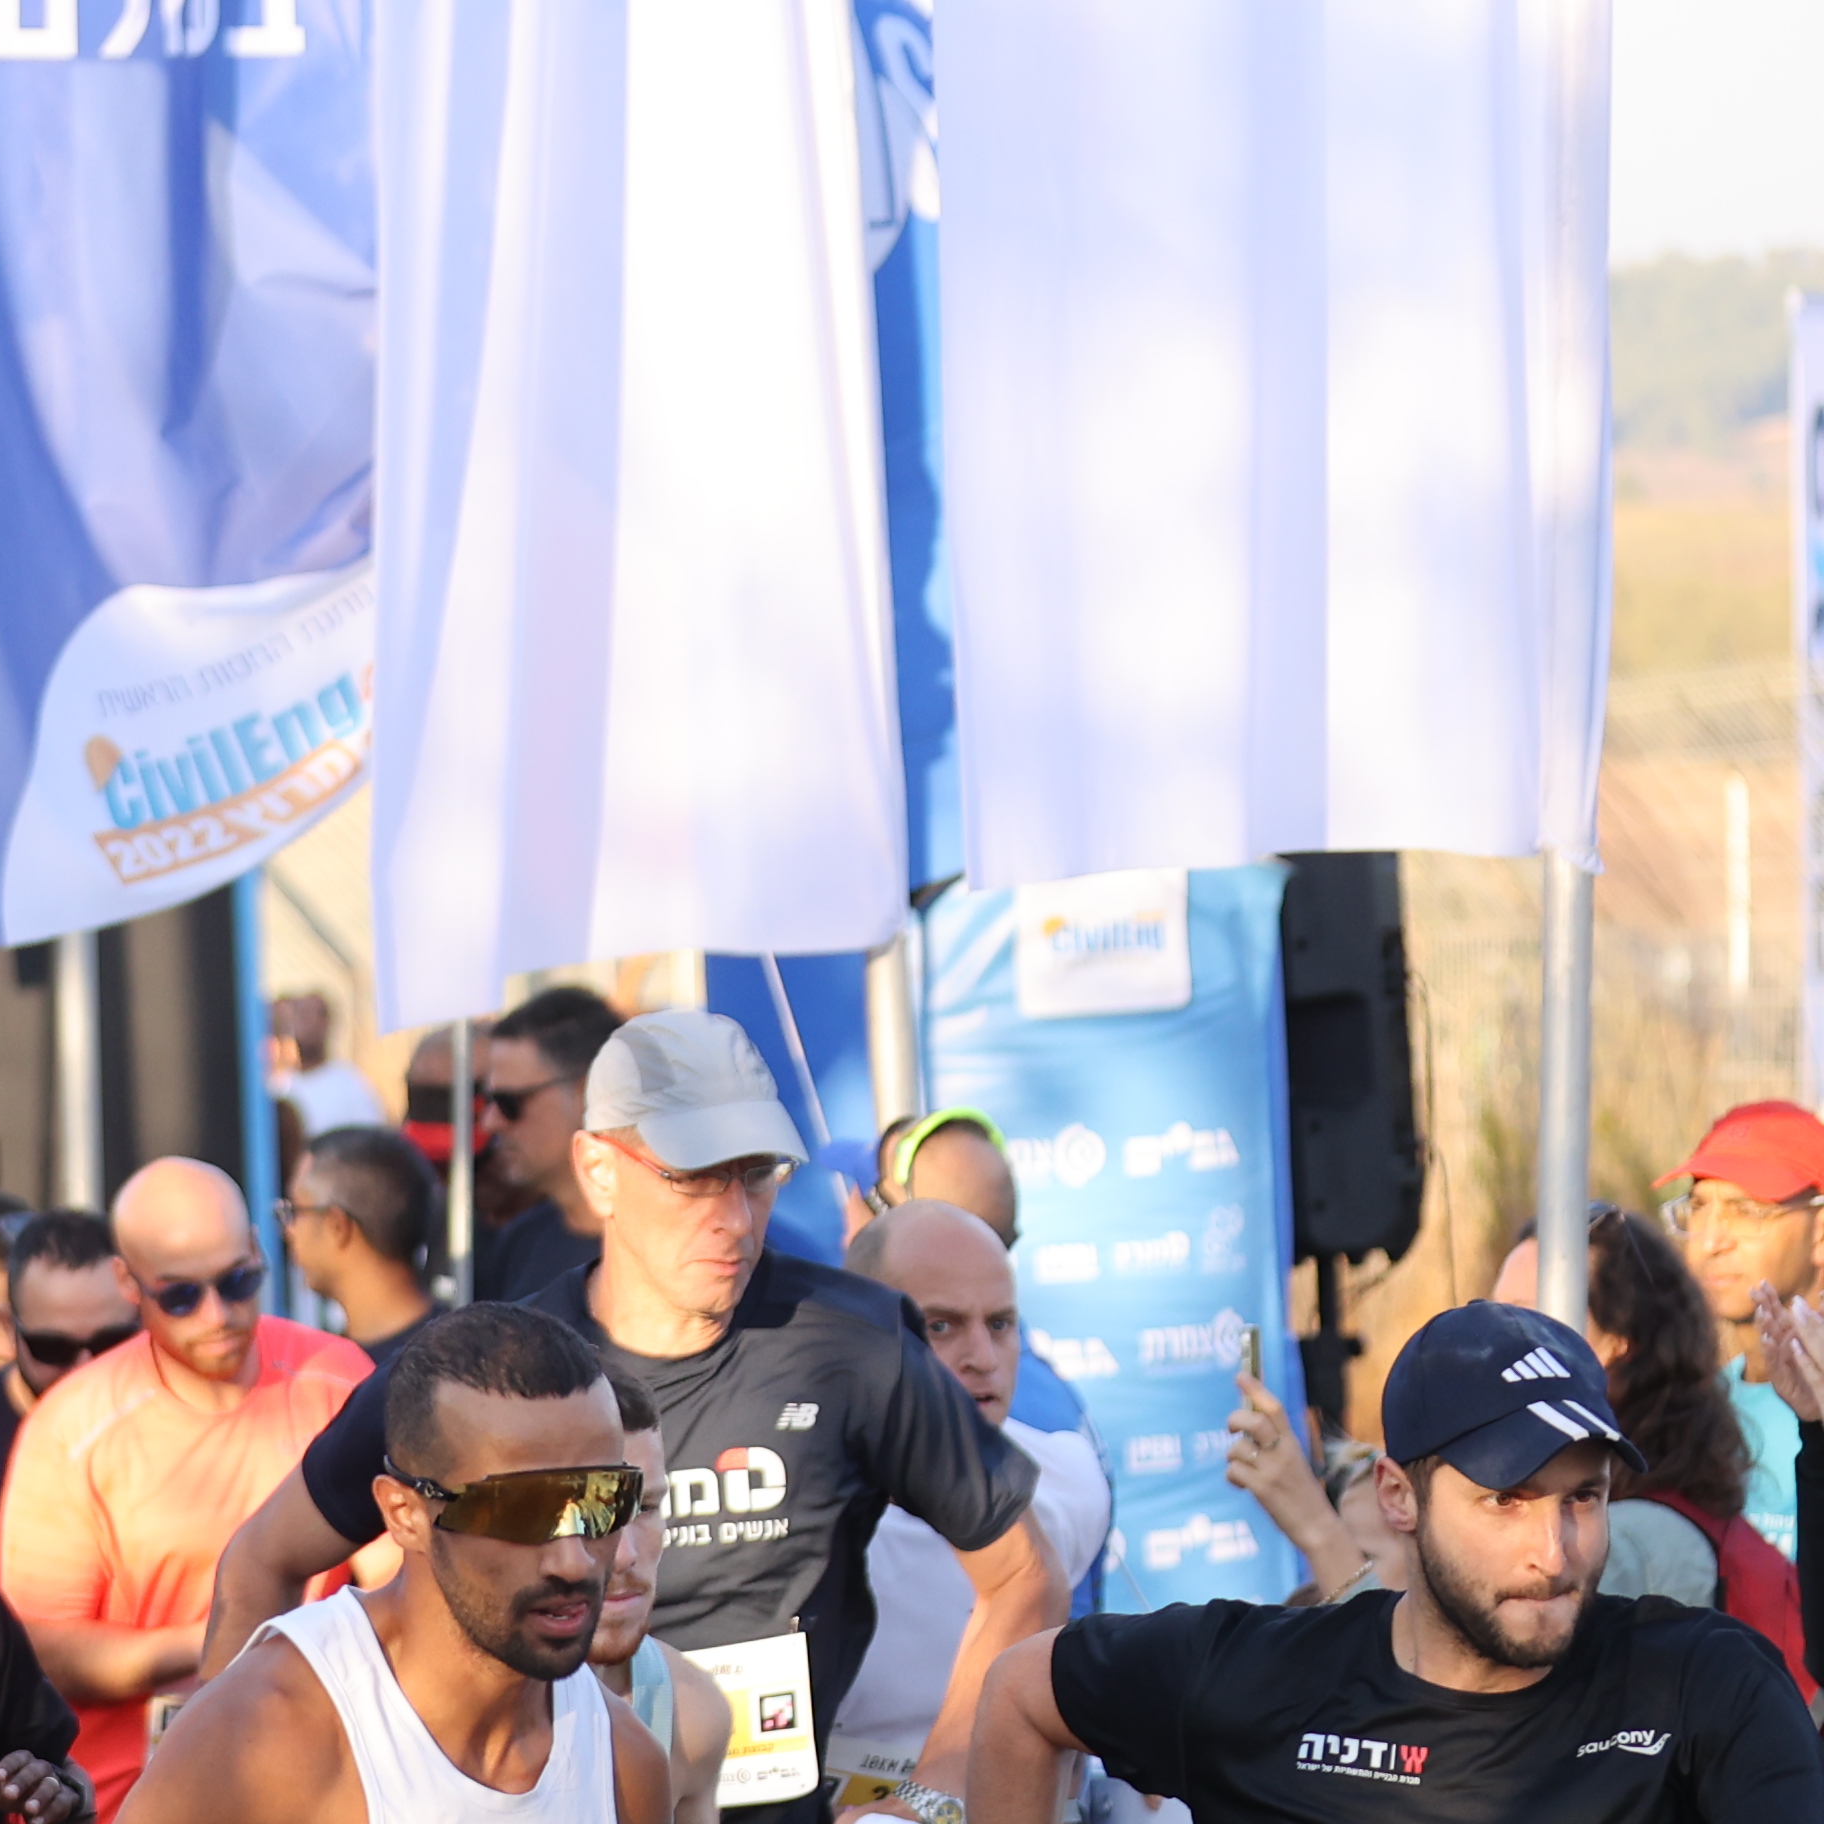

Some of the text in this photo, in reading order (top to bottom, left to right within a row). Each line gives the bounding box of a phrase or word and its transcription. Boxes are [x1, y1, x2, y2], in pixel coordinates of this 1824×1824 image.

[104, 672, 365, 830] CivilEng
[109, 815, 238, 875] 2022
[718, 1518, 788, 1544] אנשים
[1298, 1732, 1388, 1768] דניה
[1575, 1729, 1657, 1758] saucony
[860, 1754, 900, 1771] 10KM
